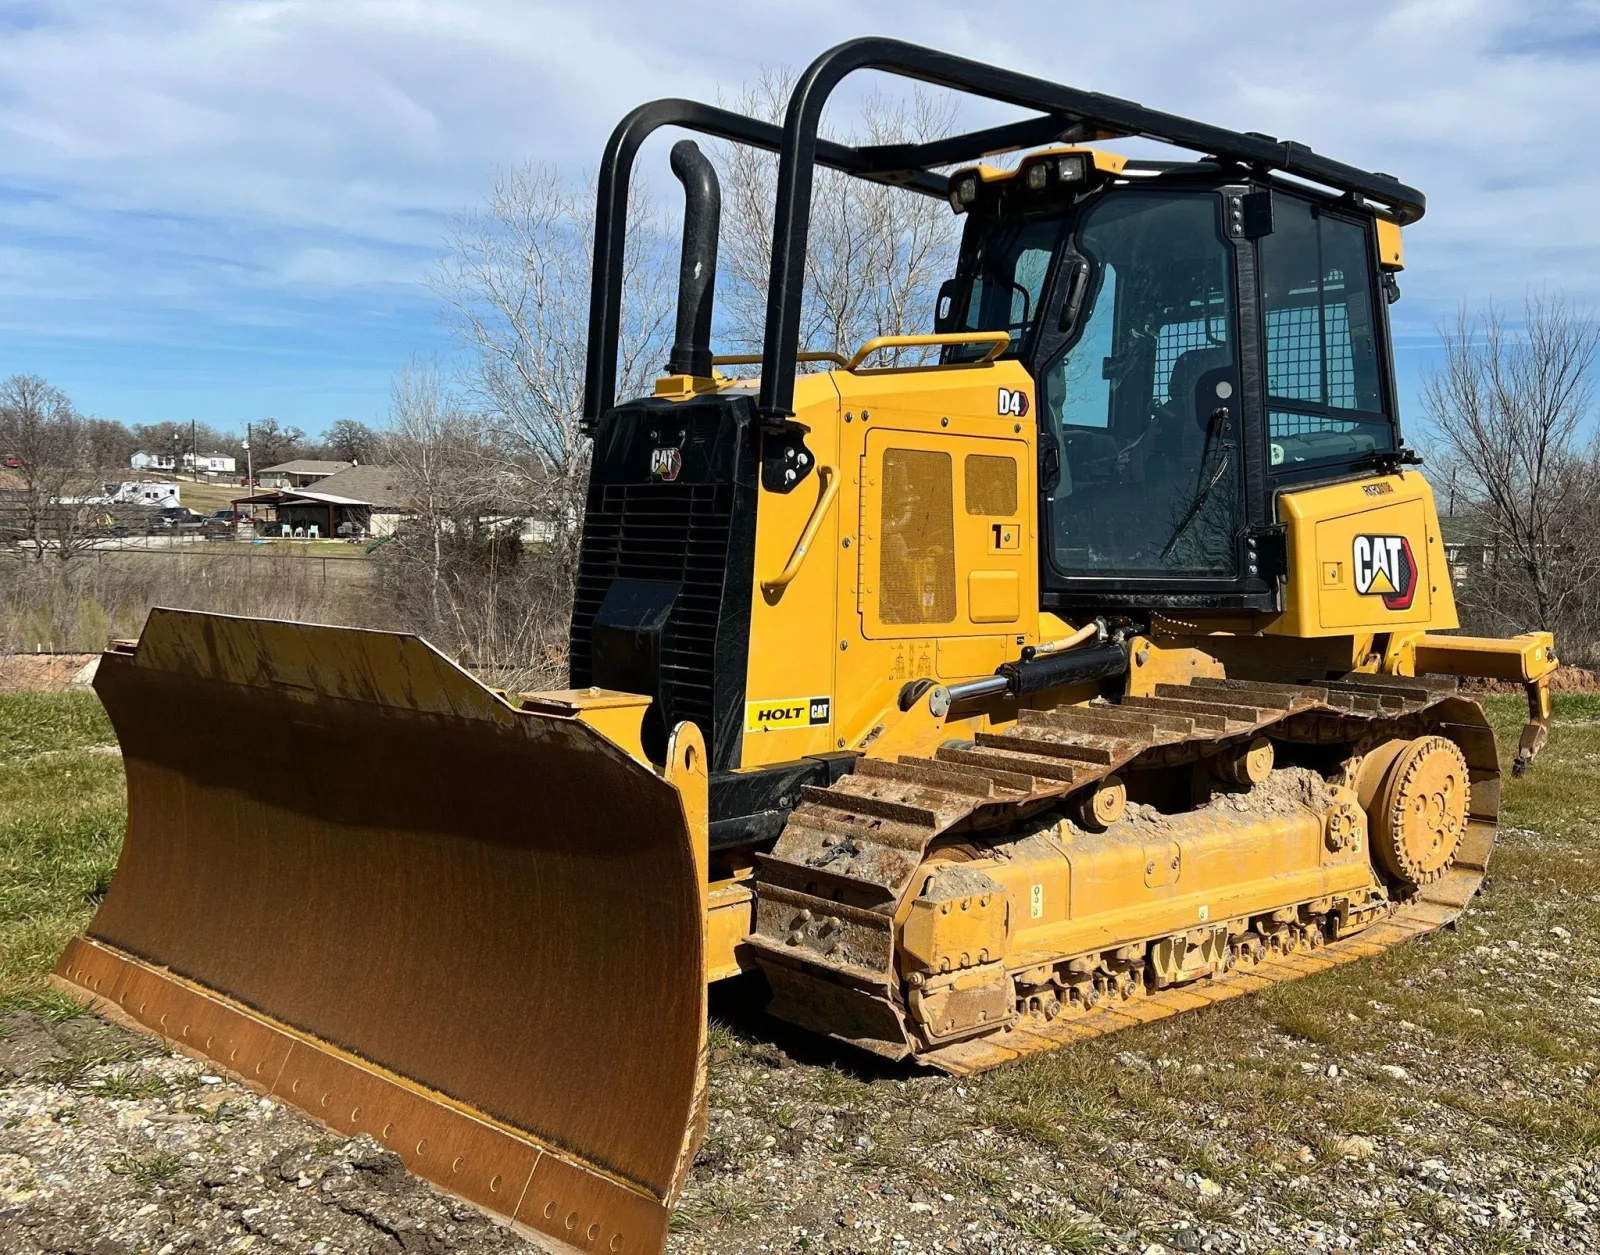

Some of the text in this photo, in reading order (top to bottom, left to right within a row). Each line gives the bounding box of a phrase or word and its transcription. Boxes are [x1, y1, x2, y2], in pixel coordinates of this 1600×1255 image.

[999, 388, 1021, 416] D4
[651, 448, 675, 473] CAT
[1353, 535, 1402, 594] CAT
[758, 704, 829, 721] HOLT CAT
